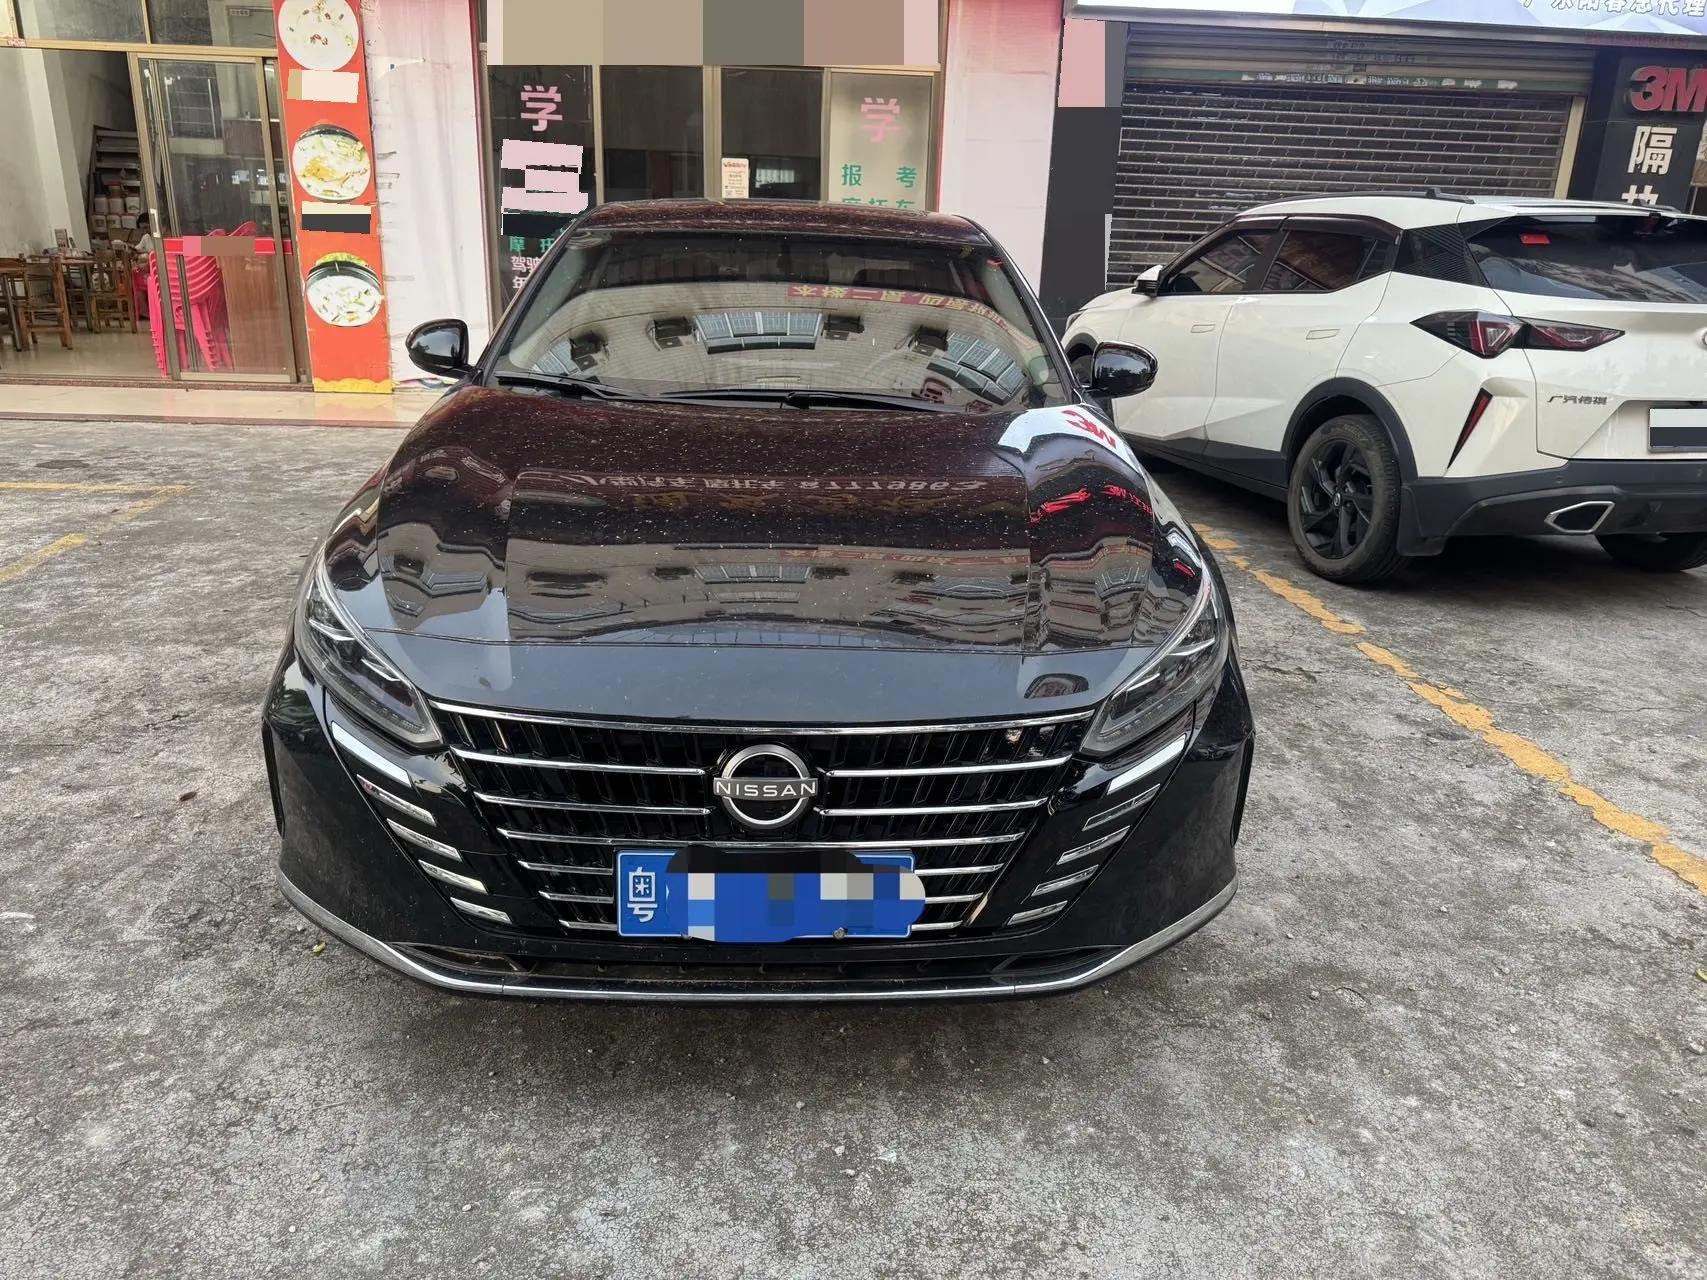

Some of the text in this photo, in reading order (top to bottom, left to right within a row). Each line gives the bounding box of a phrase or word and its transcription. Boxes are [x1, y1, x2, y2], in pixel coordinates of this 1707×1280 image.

[520, 85, 563, 132] 学
[1630, 65, 1707, 112] 3M
[860, 97, 901, 143] 学
[716, 781, 817, 797] NISSAN
[627, 866, 658, 923] 粤
